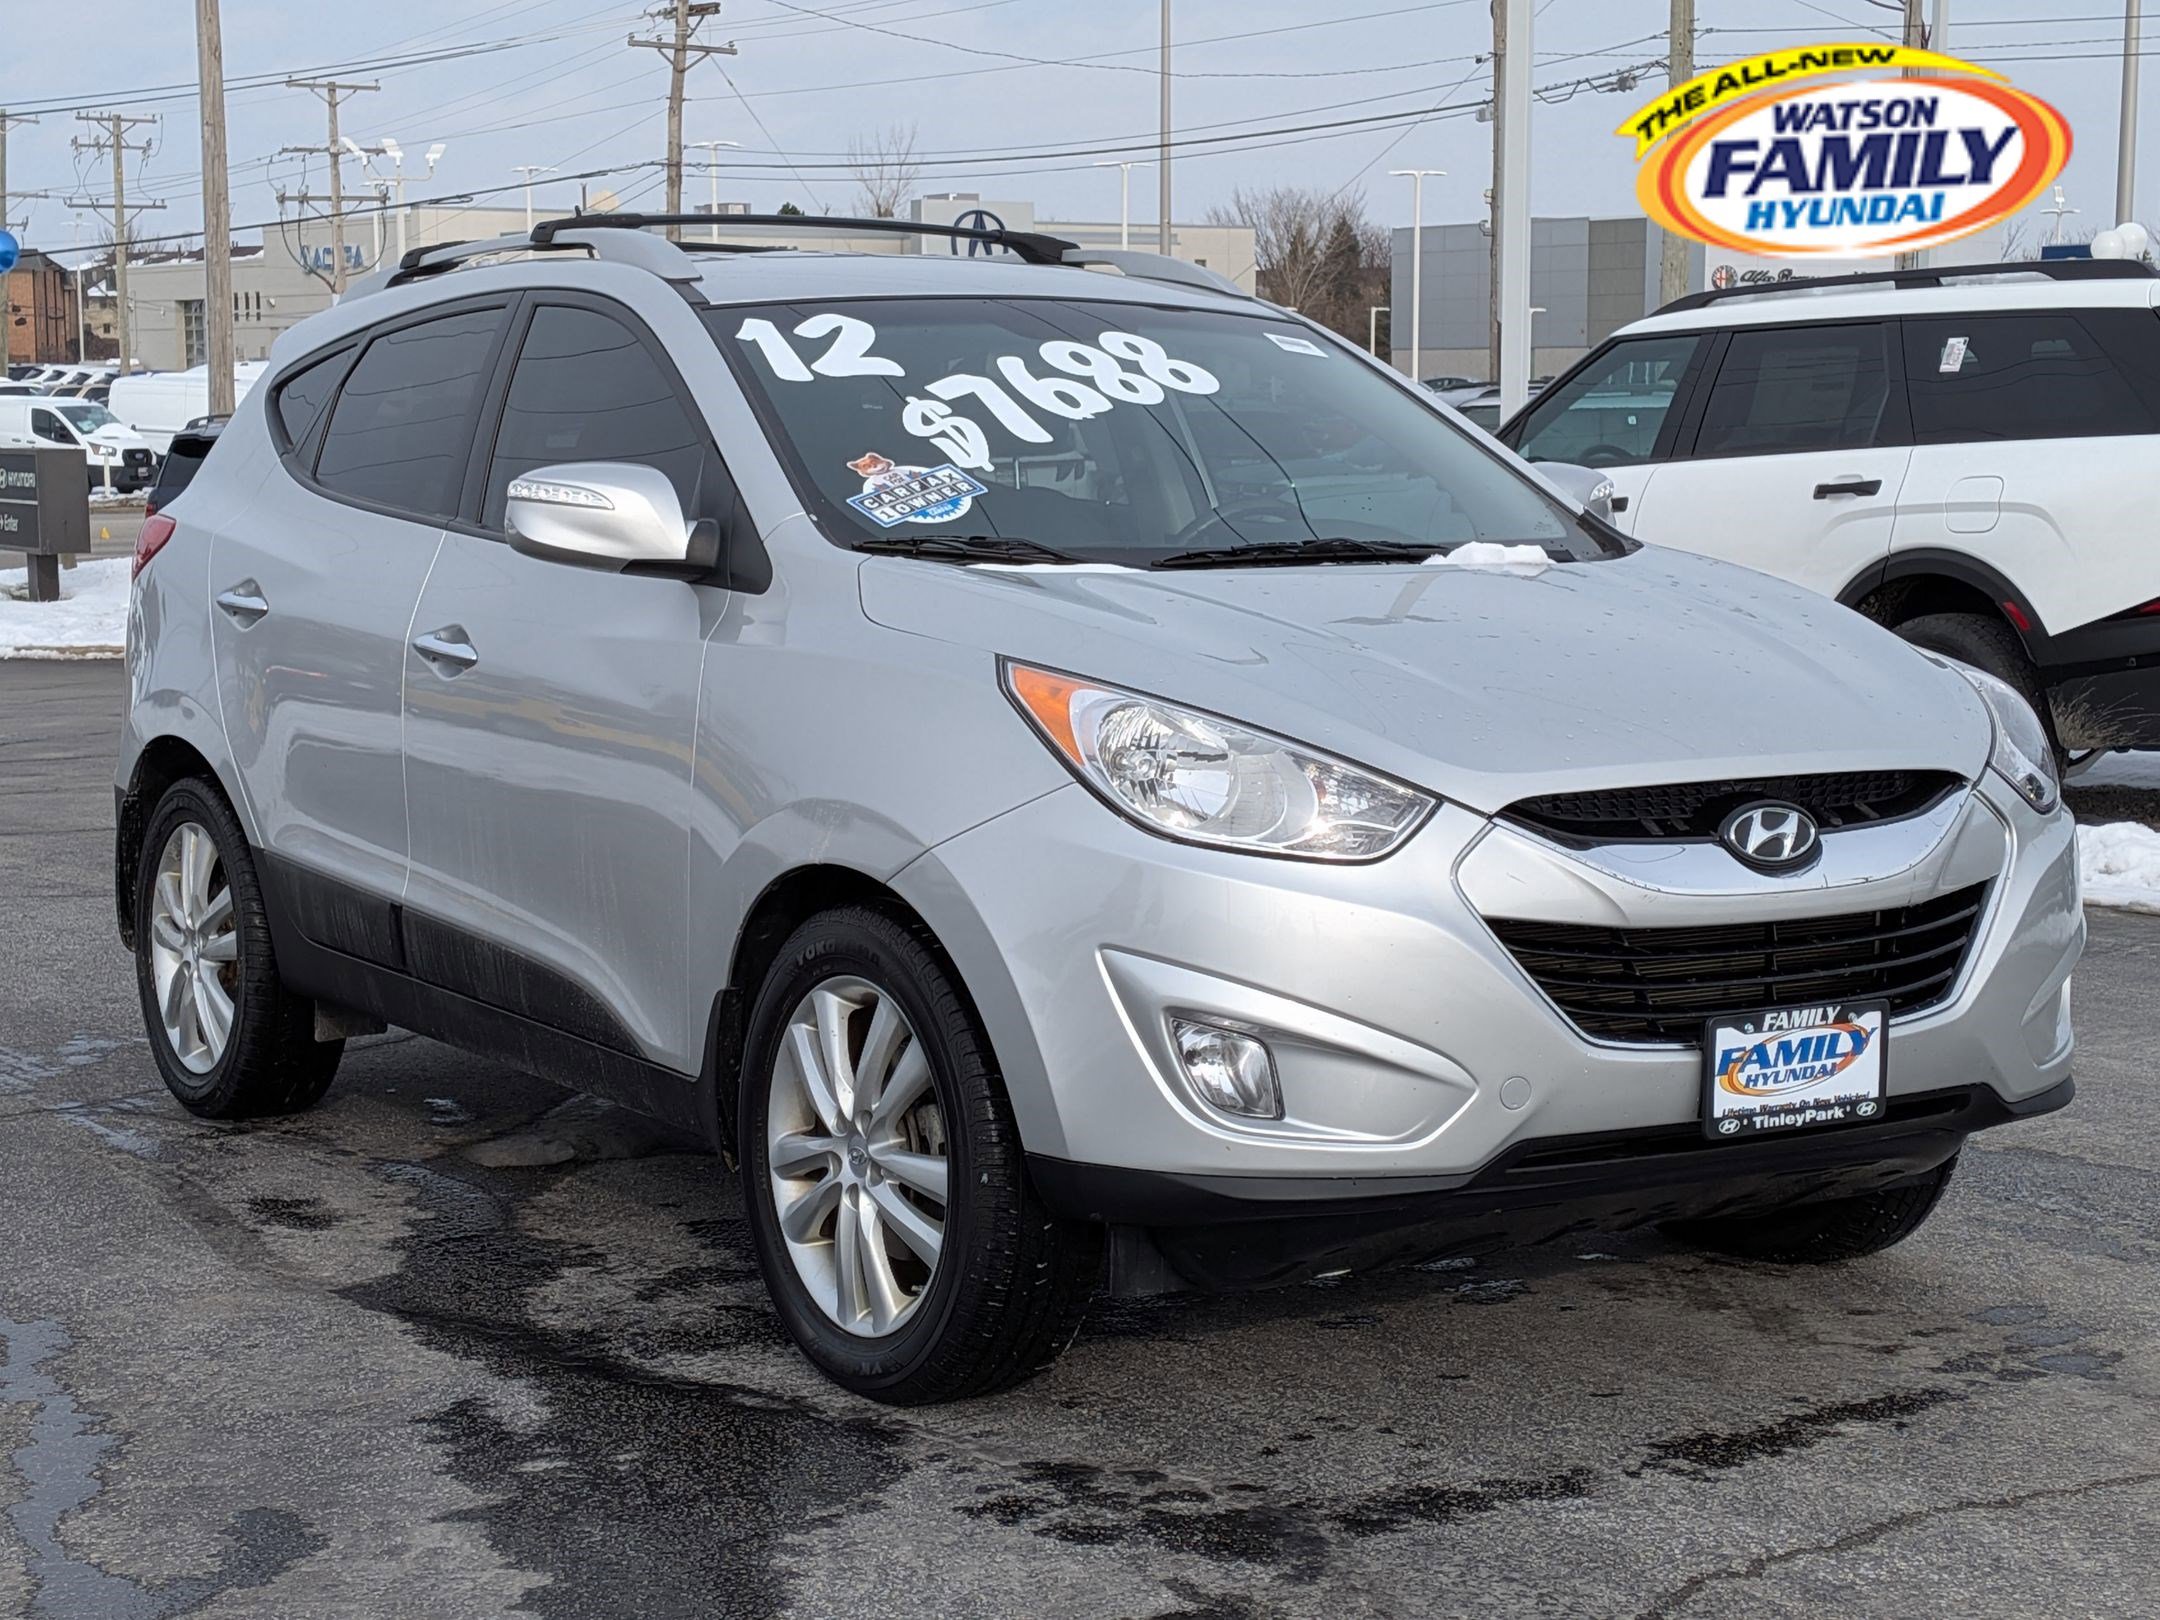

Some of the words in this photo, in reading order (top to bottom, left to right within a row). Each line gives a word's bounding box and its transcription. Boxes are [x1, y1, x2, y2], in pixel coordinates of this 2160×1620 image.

[313, 245, 364, 270] ACRA
[735, 313, 905, 382] 12
[902, 331, 1220, 472] $7688
[862, 473, 960, 509] CARFAX
[1762, 1006, 1842, 1031] FAMILY
[1715, 1027, 1879, 1077] FAMILY
[1744, 1063, 1839, 1089] HYUNDAI
[1722, 1105, 1757, 1118] Lifetime
[1759, 1101, 1797, 1113] Warranty
